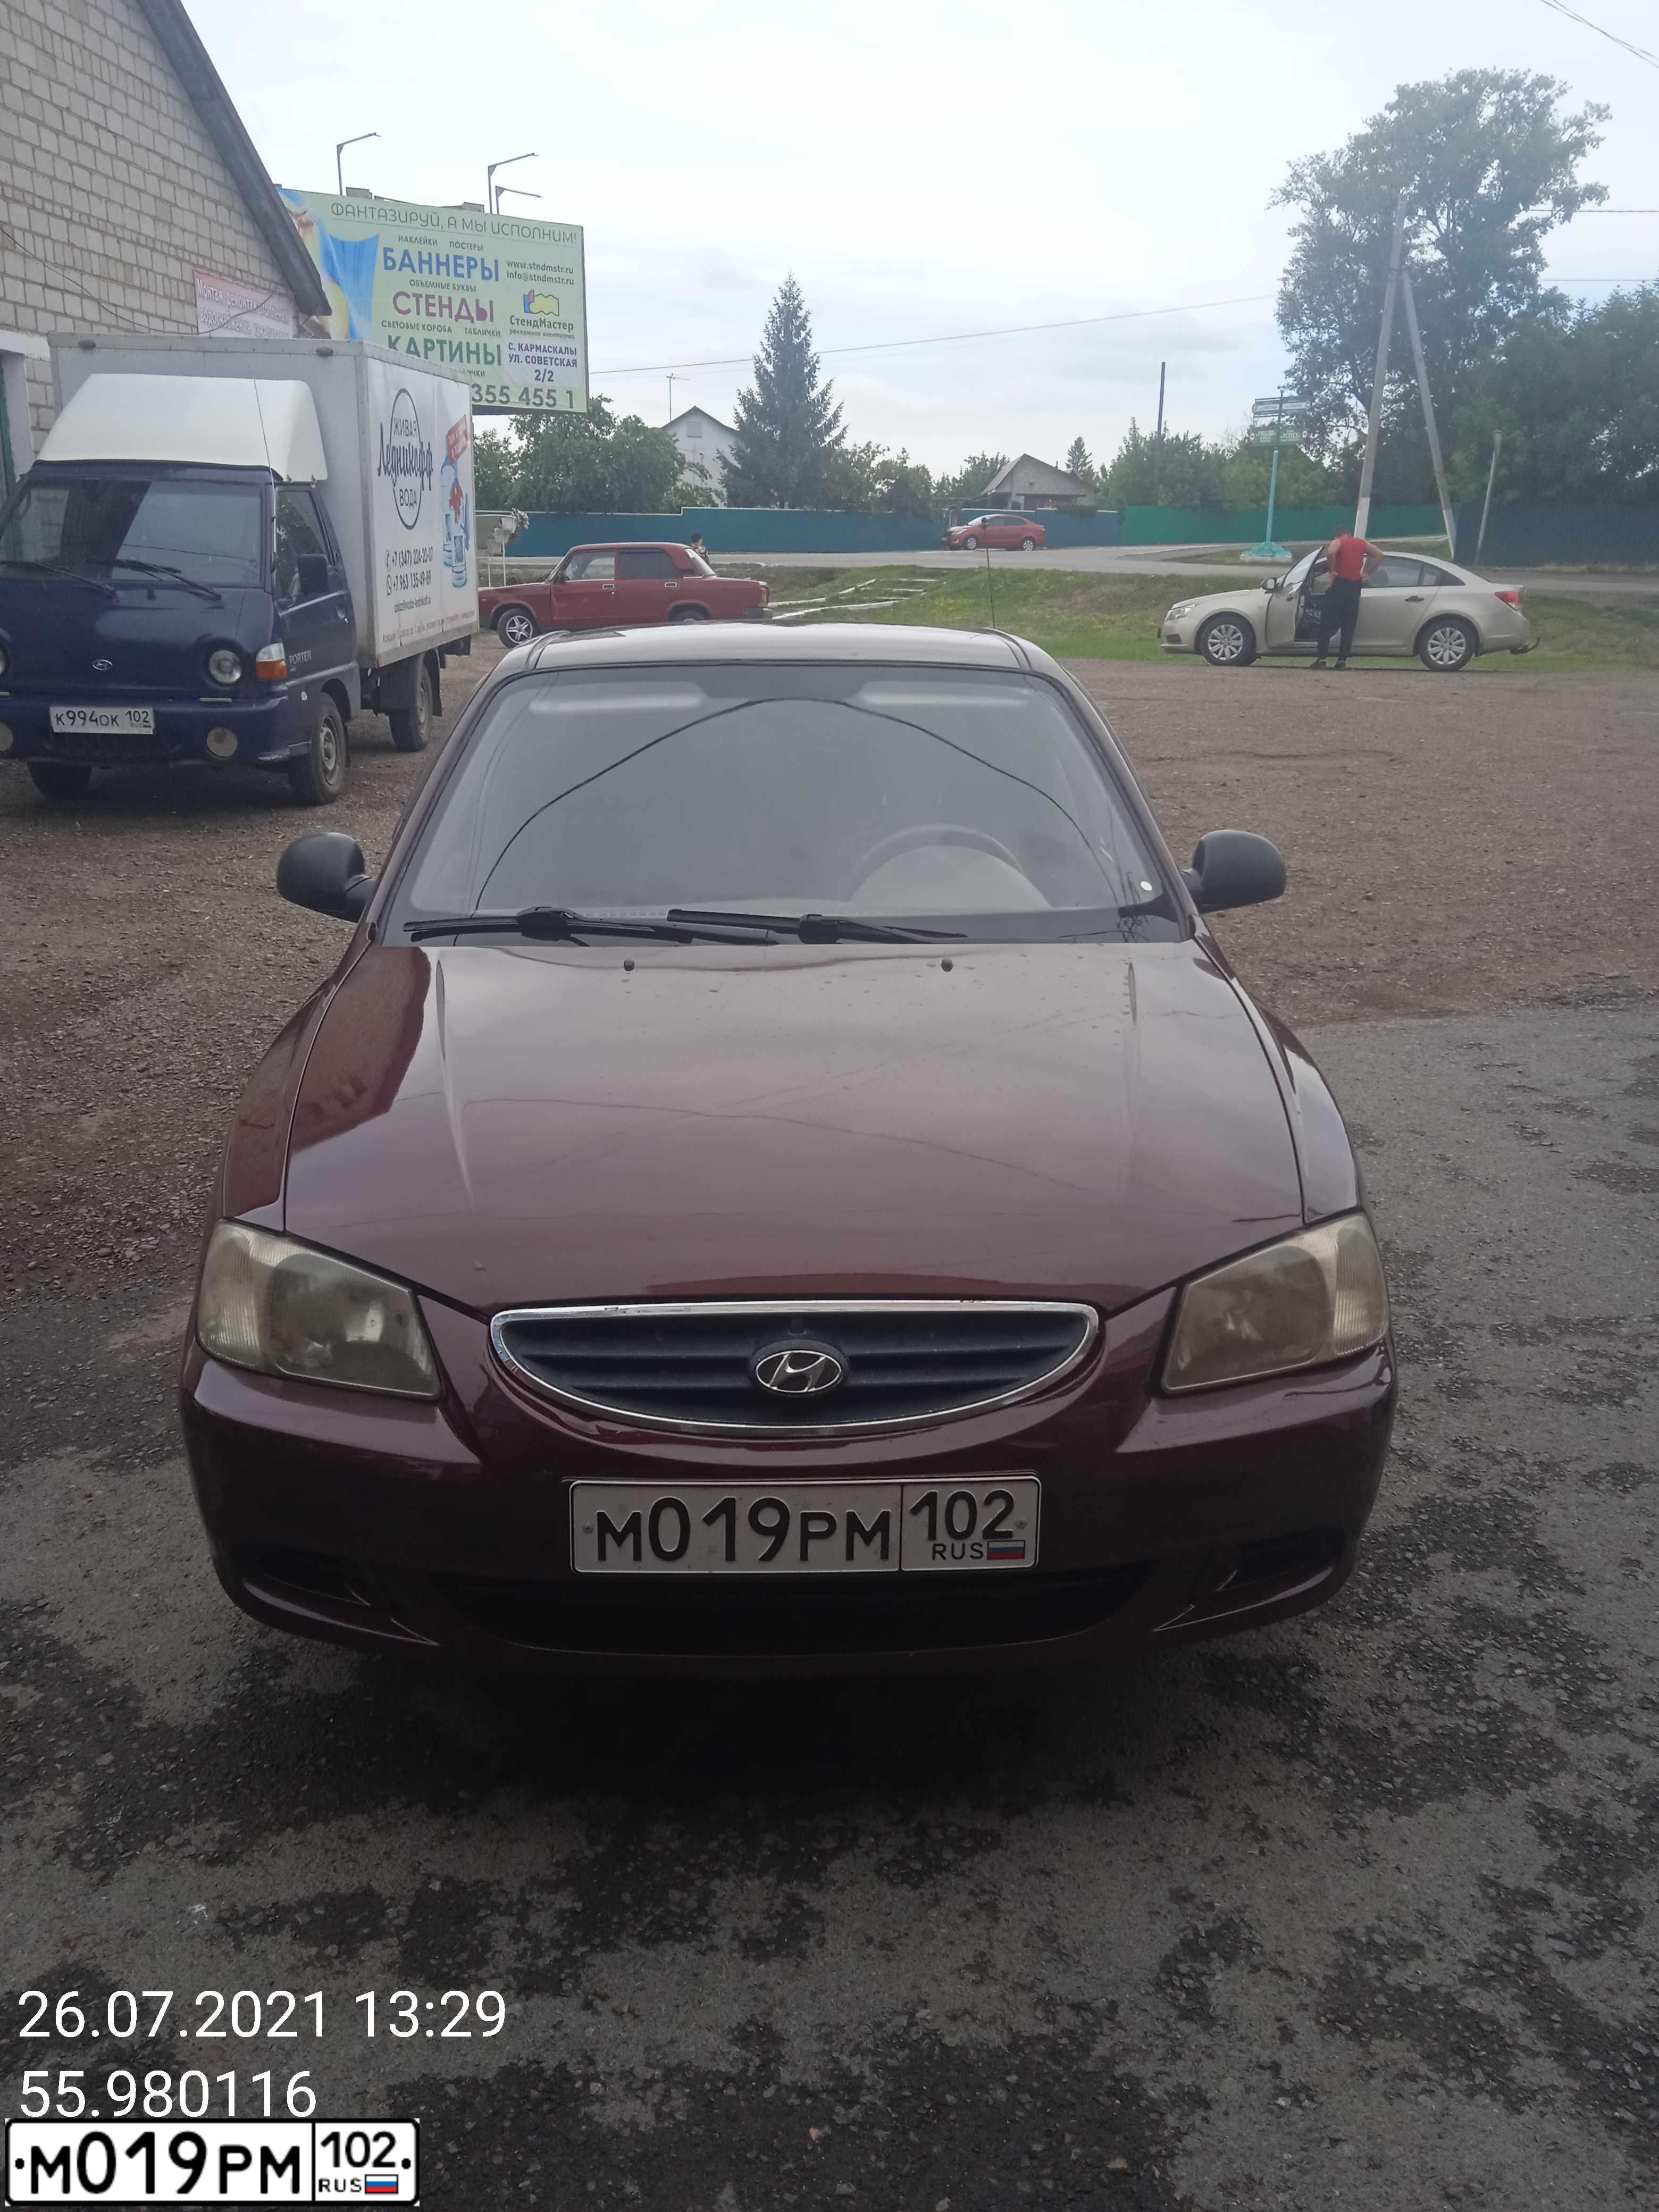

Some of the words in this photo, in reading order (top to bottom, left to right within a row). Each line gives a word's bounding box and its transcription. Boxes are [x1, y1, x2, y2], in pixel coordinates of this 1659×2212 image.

[331, 203, 443, 228] ФАНТАЗИРУЙ,
[448, 216, 457, 229] А
[462, 218, 486, 232] МЫ
[491, 222, 577, 244] ИСПОЛНИМ!
[399, 235, 438, 246] НАКЛЕЙКИ
[449, 241, 483, 252] ПОСТЕРЫ
[383, 247, 499, 281] БАННЕРЫ
[507, 261, 574, 274] www.stndmstr.ru
[409, 279, 450, 290] ОБЪЕМНЫЕ
[453, 283, 476, 292] БУКВЫ
[507, 270, 574, 285] info@stndmstr.ru
[392, 291, 494, 324] СТЕНДЫ
[381, 320, 420, 330] СВЕТОВЫЕ
[422, 323, 453, 333] КОРОБА
[464, 328, 501, 337] ТАБЛИЧКИ
[510, 315, 574, 333] СтендМастер
[388, 335, 501, 366] КАРТИНЫ
[508, 342, 516, 351] С.
[518, 343, 577, 356] КАРМАСКАЛЫ
[508, 354, 523, 364] УЛ.
[525, 355, 577, 367] СОВЕТСКАЯ
[534, 368, 554, 382] 2/2
[471, 383, 510, 405] 355
[518, 387, 557, 408] 455
[566, 390, 574, 409] 1
[393, 418, 417, 438] ЖИВАЯ
[399, 488, 417, 508] ВОДА
[289, 650, 312, 665] PORTER
[56, 710, 120, 727] К994ОК
[125, 710, 149, 723] 102
[596, 1496, 891, 1562] М019РМ
[909, 1489, 1016, 1541] 102
[932, 1540, 985, 1561] RUS
